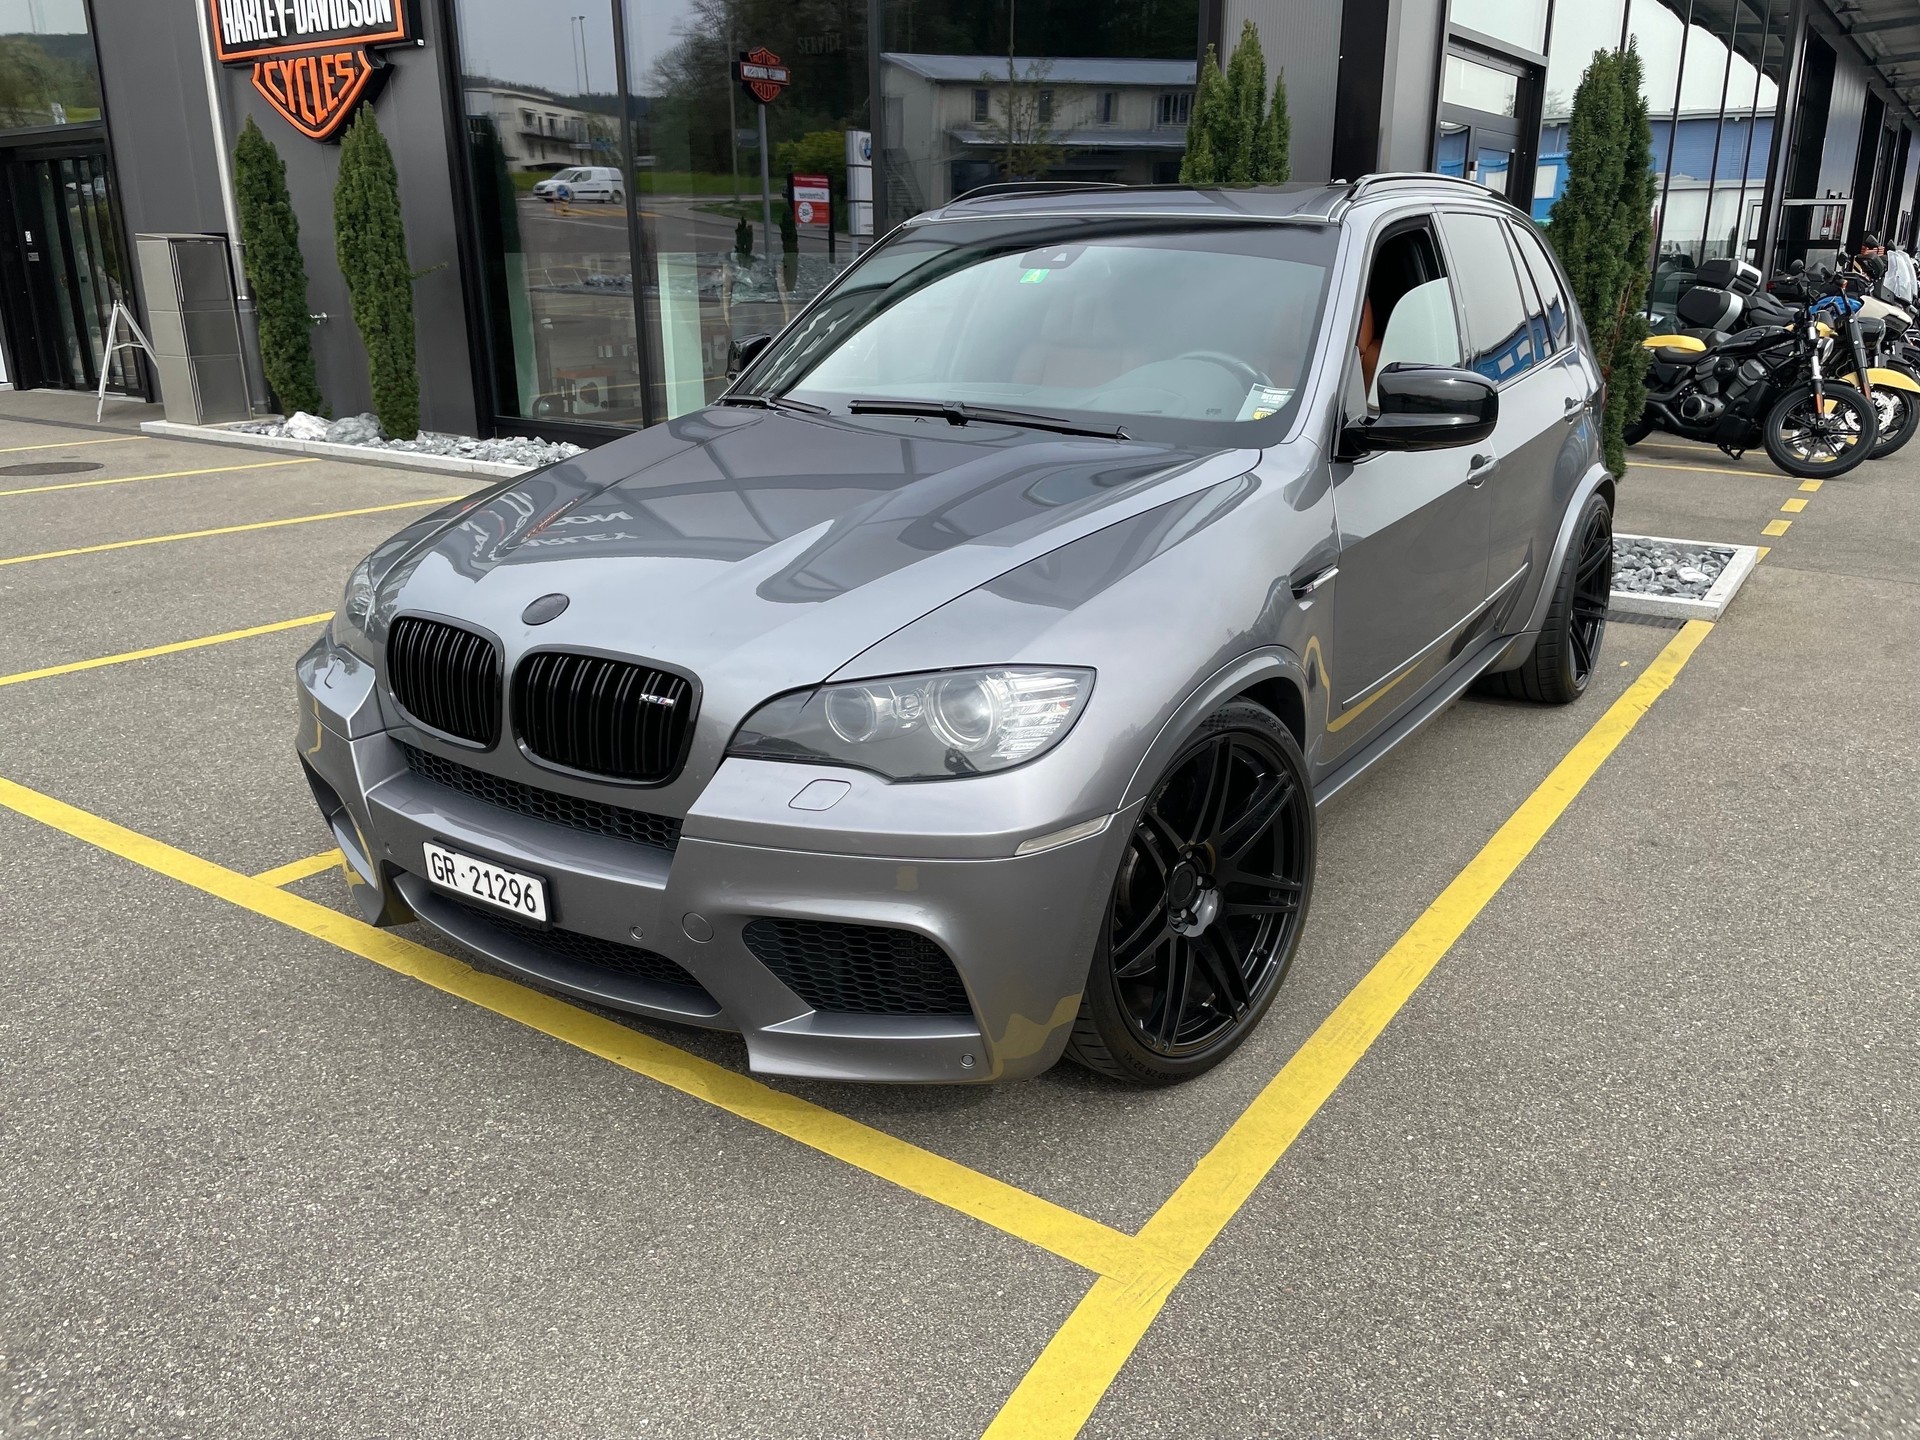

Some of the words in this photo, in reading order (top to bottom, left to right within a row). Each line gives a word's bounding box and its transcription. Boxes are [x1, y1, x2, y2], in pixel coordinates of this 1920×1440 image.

[221, 0, 393, 45] HARLEY-DAVIDSON
[263, 52, 356, 126] CYCLES
[469, 865, 537, 913] 21296
